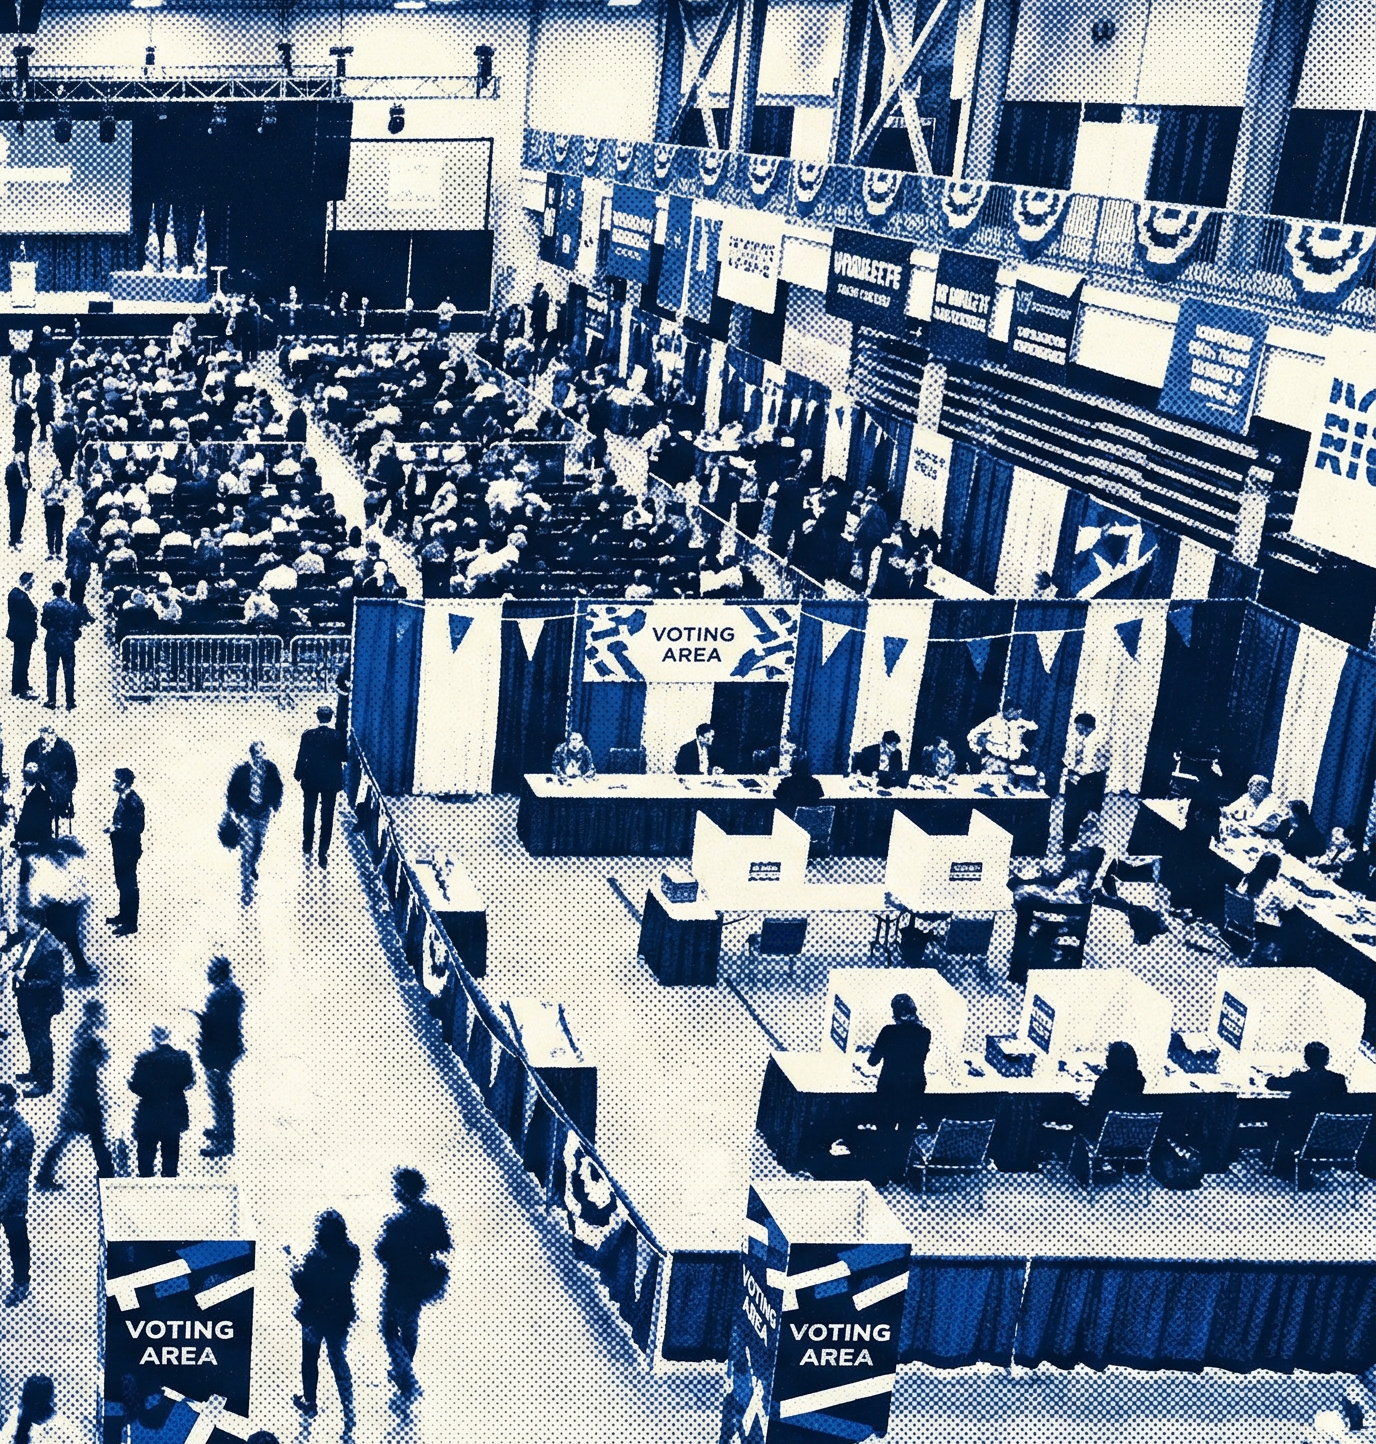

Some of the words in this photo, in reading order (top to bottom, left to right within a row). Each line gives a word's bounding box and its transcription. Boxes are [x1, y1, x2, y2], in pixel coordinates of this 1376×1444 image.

[652, 626, 735, 642] VOTING
[661, 647, 722, 663] AREA
[742, 1263, 777, 1330] VOTING
[125, 1320, 234, 1340] VOTING
[742, 1295, 768, 1348] AREA
[789, 1323, 891, 1342] VOTING
[139, 1346, 218, 1366] AREA
[799, 1348, 874, 1367] AREA
